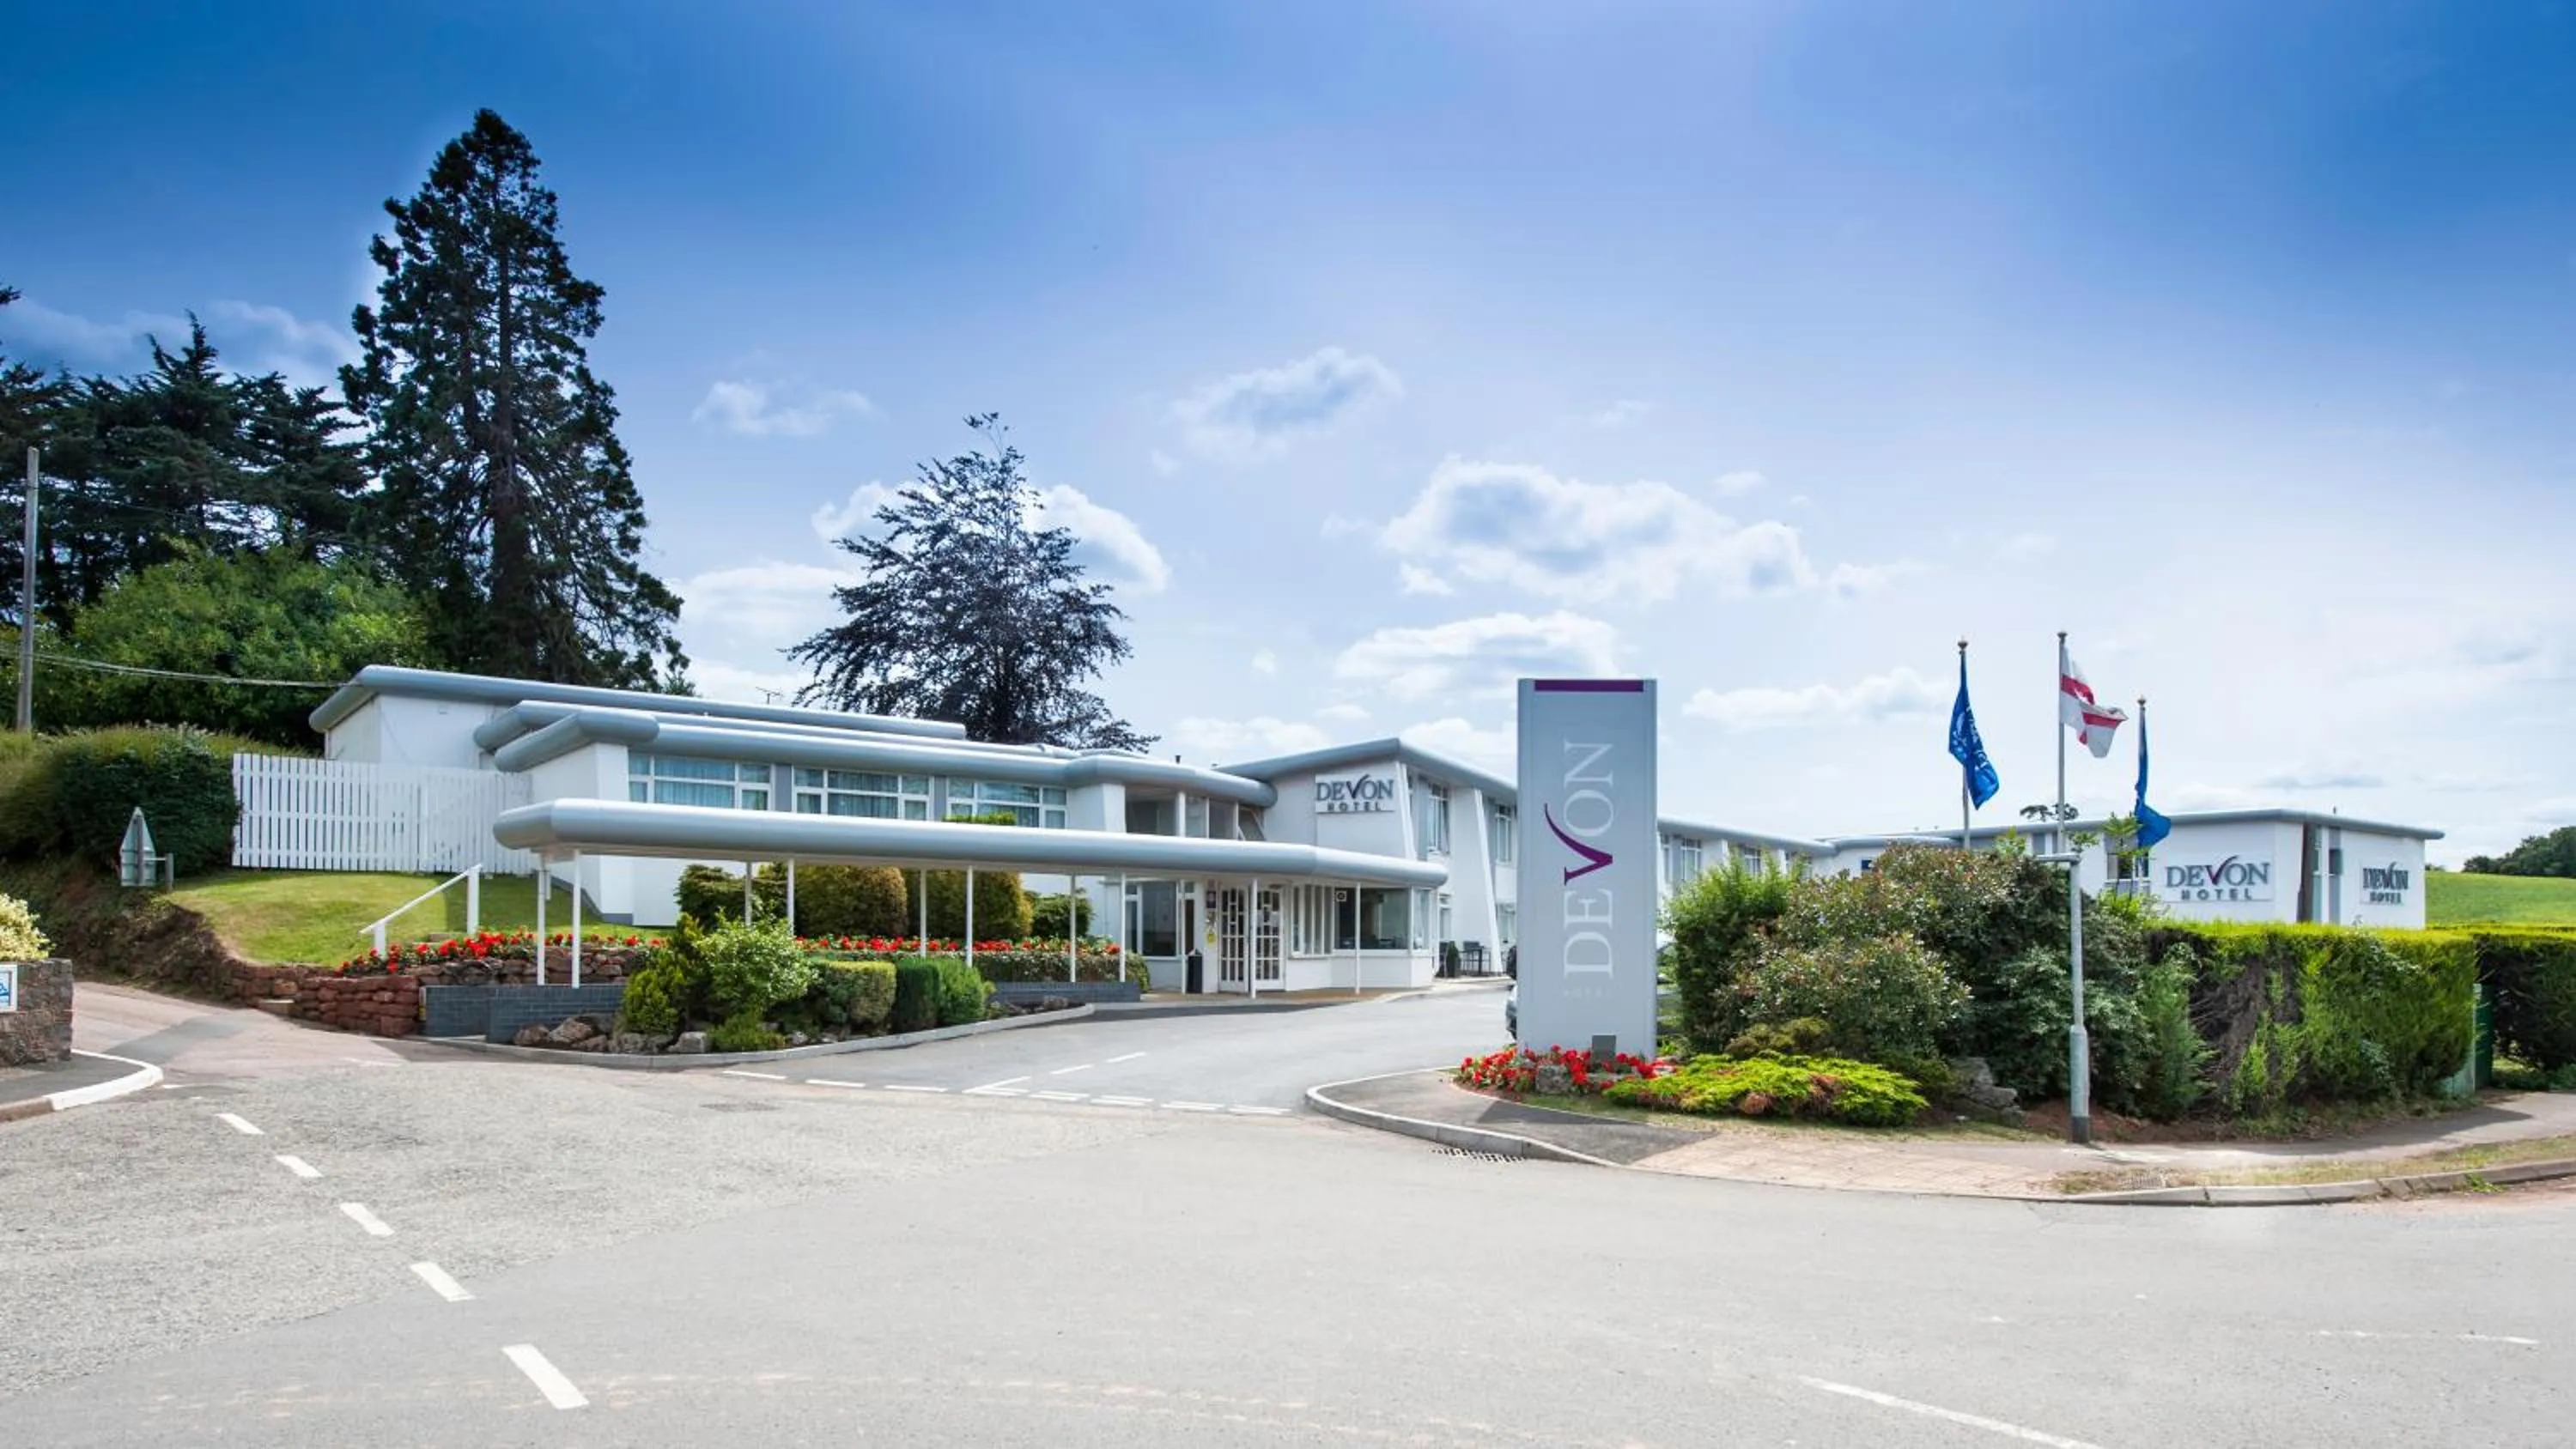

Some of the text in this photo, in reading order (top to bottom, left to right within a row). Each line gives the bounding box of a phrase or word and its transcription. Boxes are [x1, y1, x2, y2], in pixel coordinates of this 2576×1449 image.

[1316, 773, 1394, 801] DEVON
[1545, 741, 1614, 979] DEVON
[2166, 856, 2271, 888] DEVON
[2363, 862, 2409, 890] DEVON
[2181, 888, 2253, 900] HOTEL
